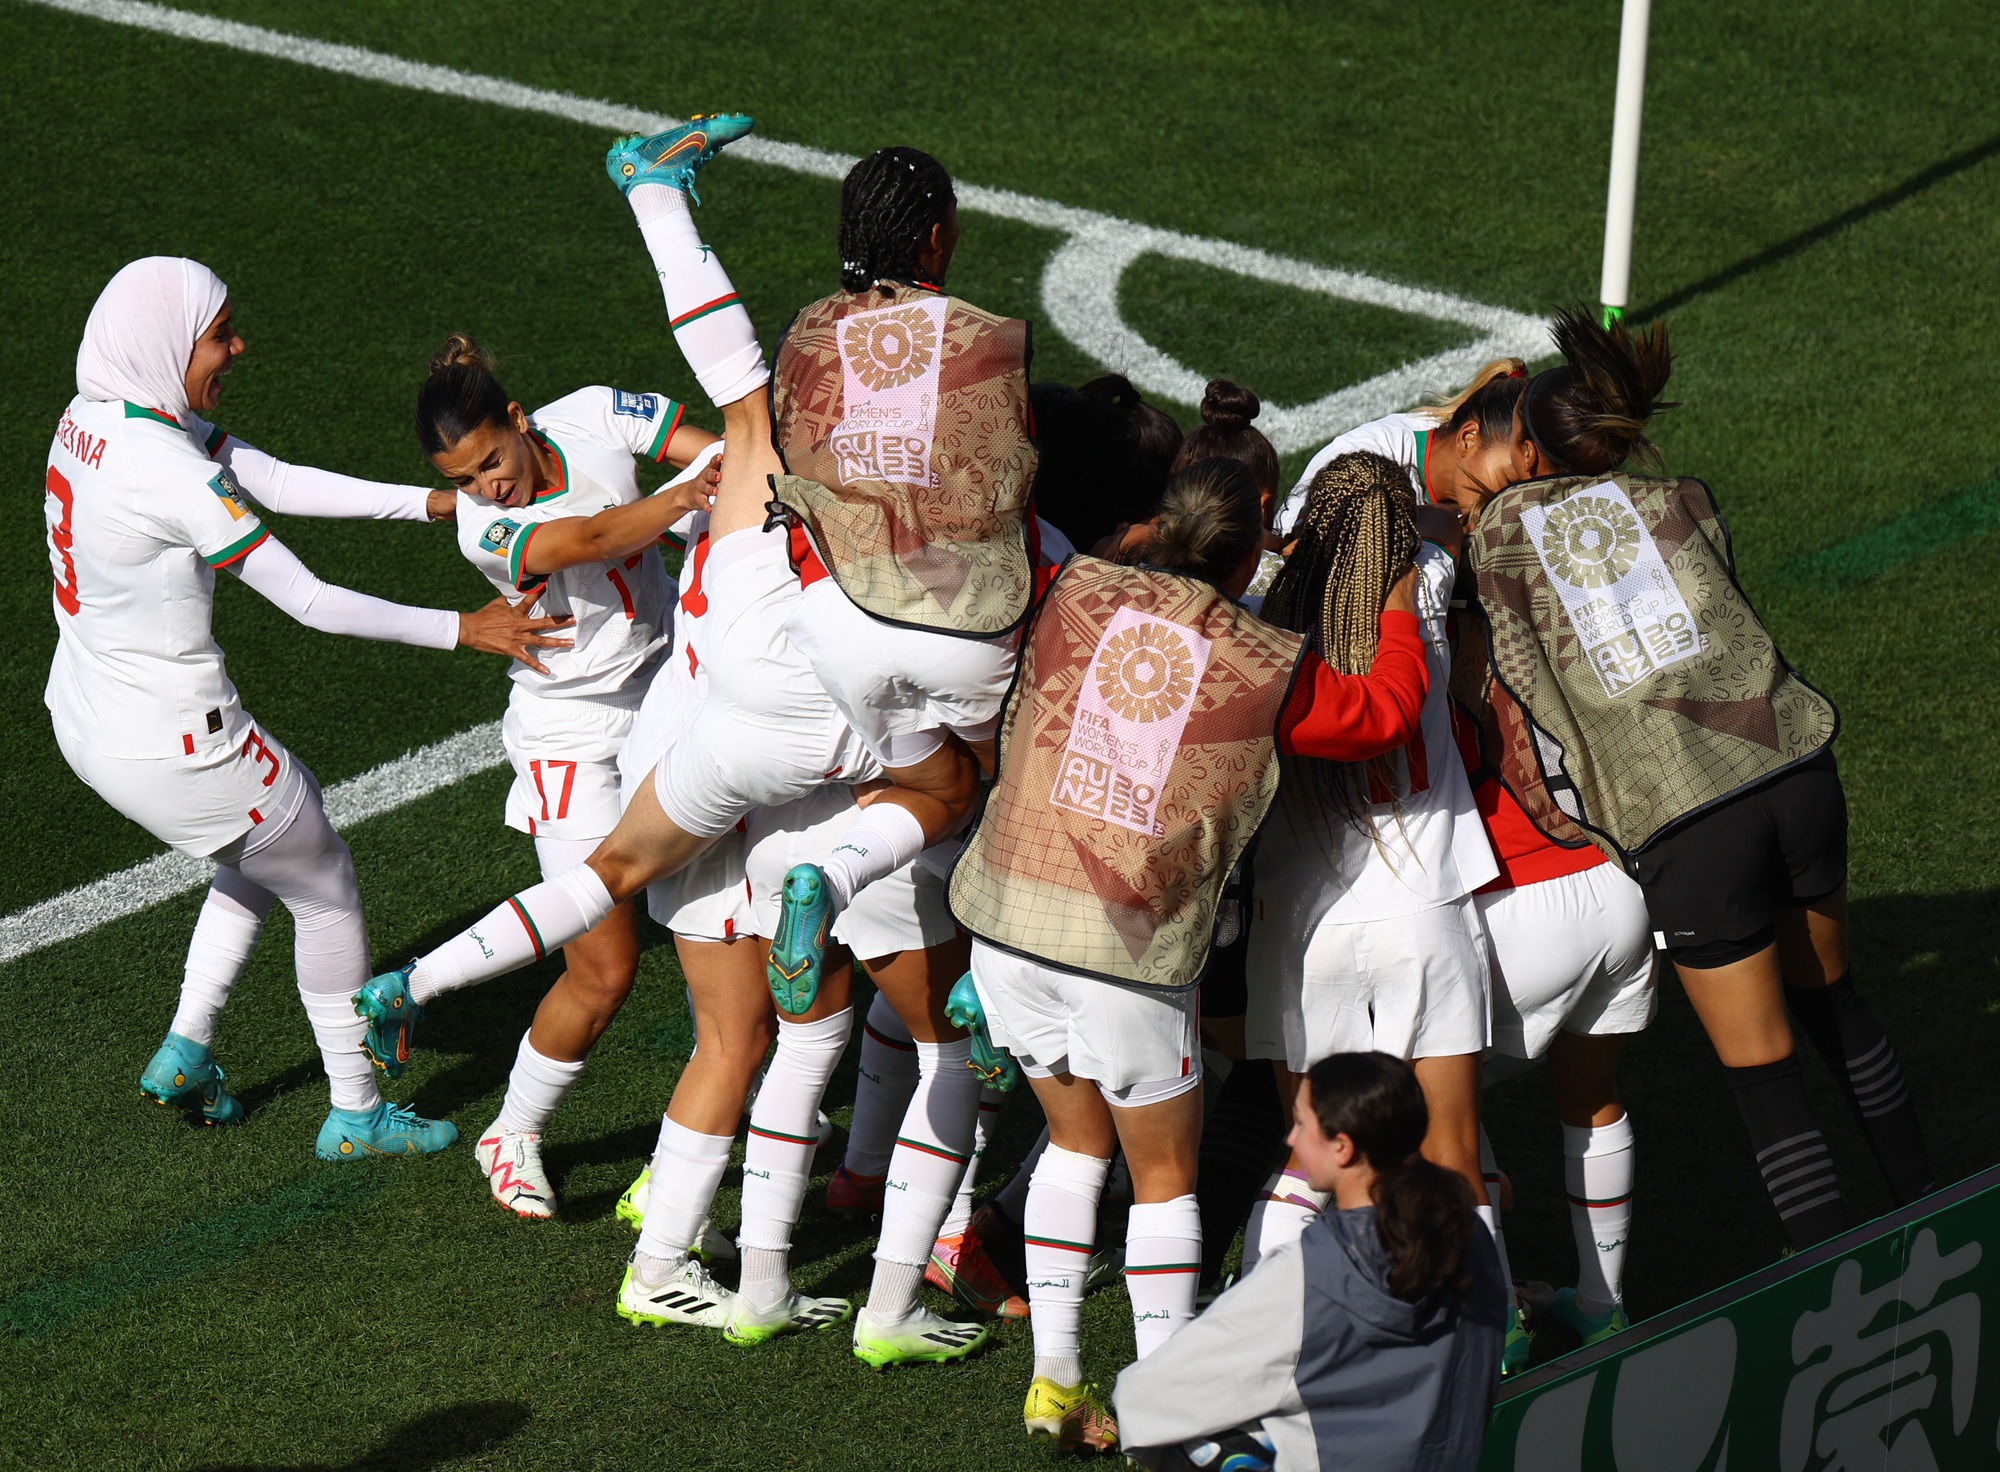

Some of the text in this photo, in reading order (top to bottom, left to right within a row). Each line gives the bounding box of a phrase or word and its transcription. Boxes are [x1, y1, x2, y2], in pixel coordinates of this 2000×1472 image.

[838, 418, 914, 431] WORLD CUP
[1574, 596, 1608, 621] FIFA
[1578, 595, 1643, 632] WOMEN'S
[1585, 600, 1660, 643] WORLD CUP
[1080, 709, 1110, 731] FIFA
[1074, 735, 1148, 770] WORLD CUP
[1078, 724, 1139, 755] WOMEN'S
[241, 728, 280, 788] 3
[529, 759, 578, 821] 17
